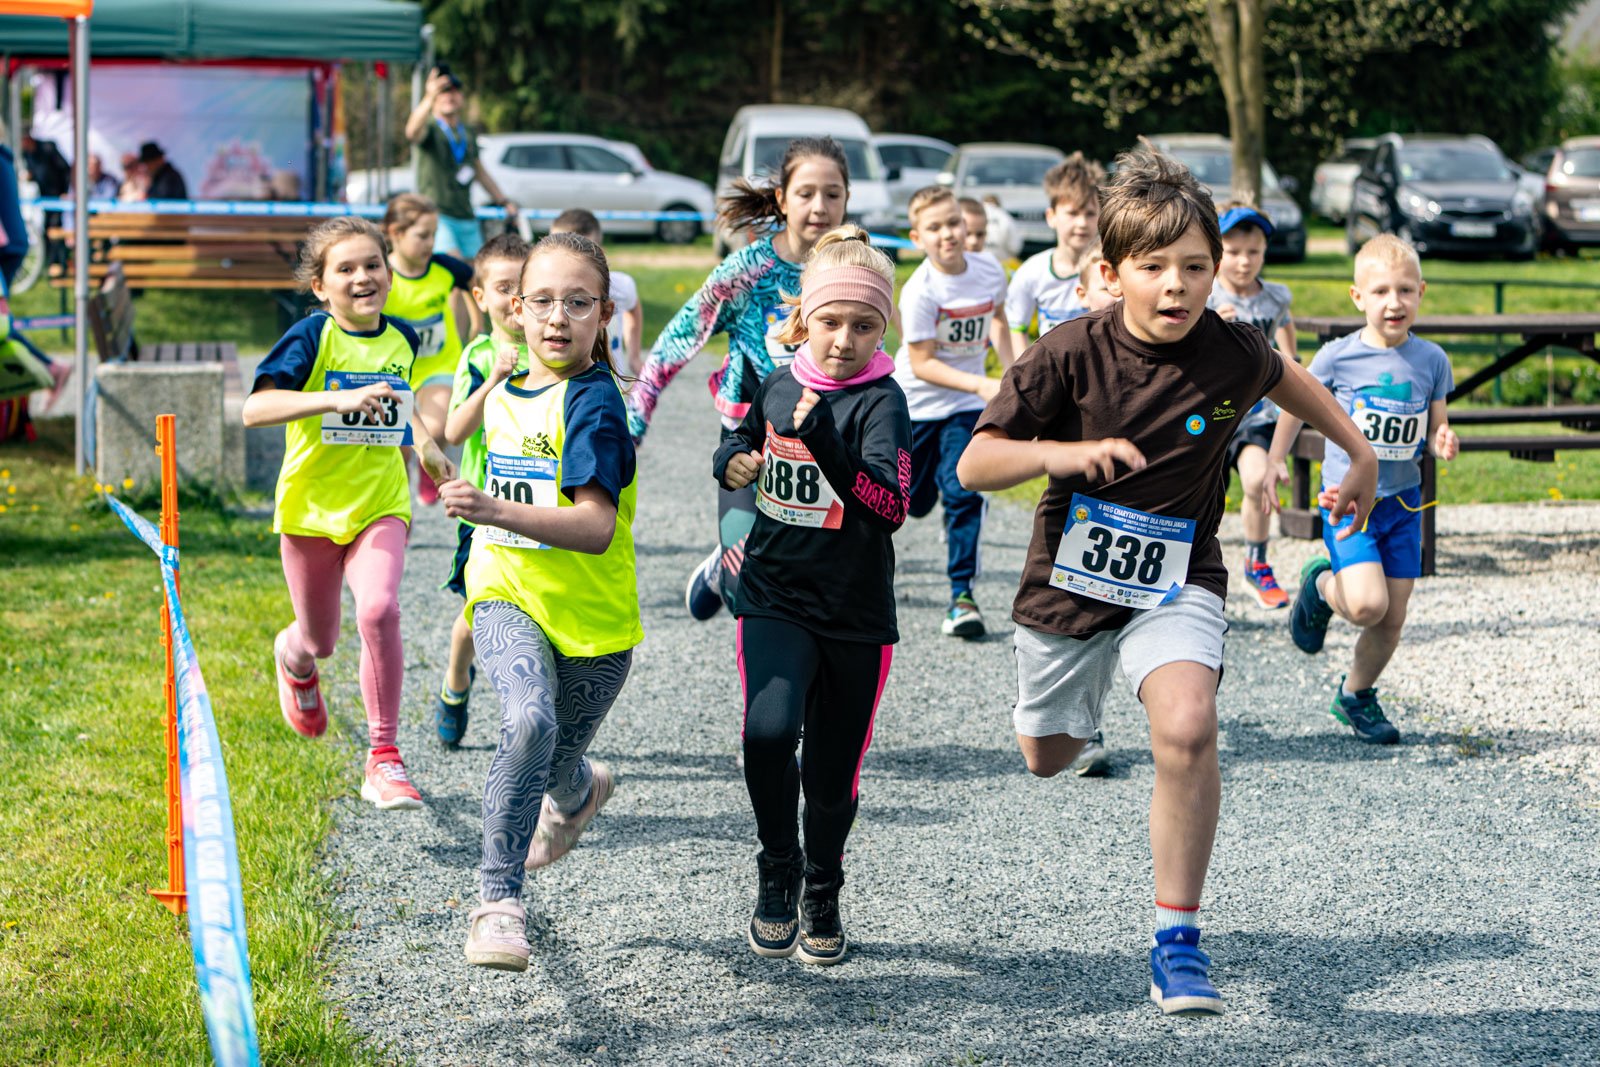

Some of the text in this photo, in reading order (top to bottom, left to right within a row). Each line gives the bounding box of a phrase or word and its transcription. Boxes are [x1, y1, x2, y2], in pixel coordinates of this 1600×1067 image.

[949, 317, 984, 342] 397
[1363, 413, 1418, 444] 360
[764, 453, 819, 504] 388
[1082, 526, 1166, 585] 338
